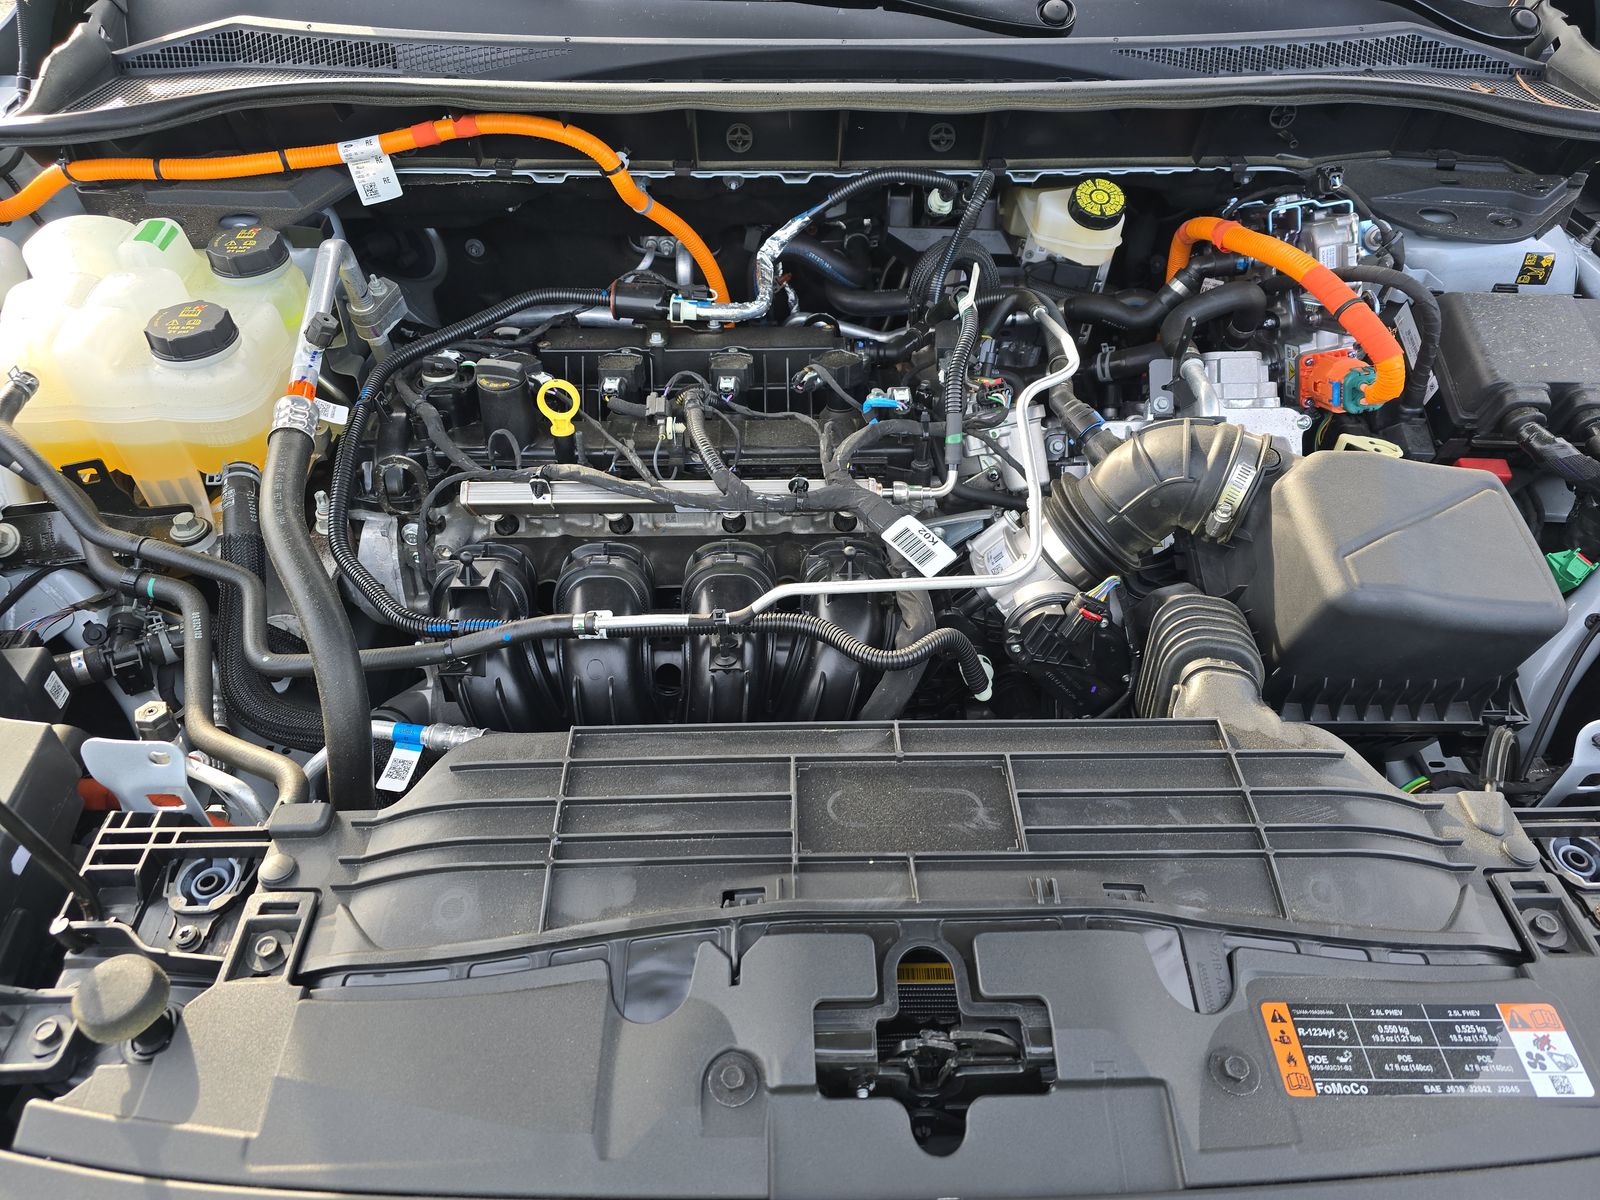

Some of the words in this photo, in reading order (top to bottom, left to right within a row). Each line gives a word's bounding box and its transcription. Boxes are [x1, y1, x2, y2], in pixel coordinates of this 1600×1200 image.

[918, 527, 939, 546] K02
[1297, 1027, 1335, 1039] R-1234yf
[1377, 1024, 1398, 1034] 0.550
[1398, 1024, 1410, 1035] kg
[1454, 1024, 1476, 1034] 0.525
[1476, 1024, 1488, 1035] kg
[1409, 1034, 1423, 1044] lbs)
[1449, 1034, 1463, 1042] 18.5
[1472, 1034, 1488, 1043] (1.15
[1307, 1055, 1329, 1064] POE
[1397, 1054, 1413, 1063] POE
[1476, 1055, 1493, 1063] POE
[1384, 1063, 1394, 1071] 4.7
[1409, 1063, 1433, 1073] (140cc)
[1464, 1064, 1474, 1072] 4.7
[1315, 1082, 1369, 1095] FoMoCo
[1423, 1085, 1442, 1093] SAE
[1446, 1085, 1465, 1093] J639
